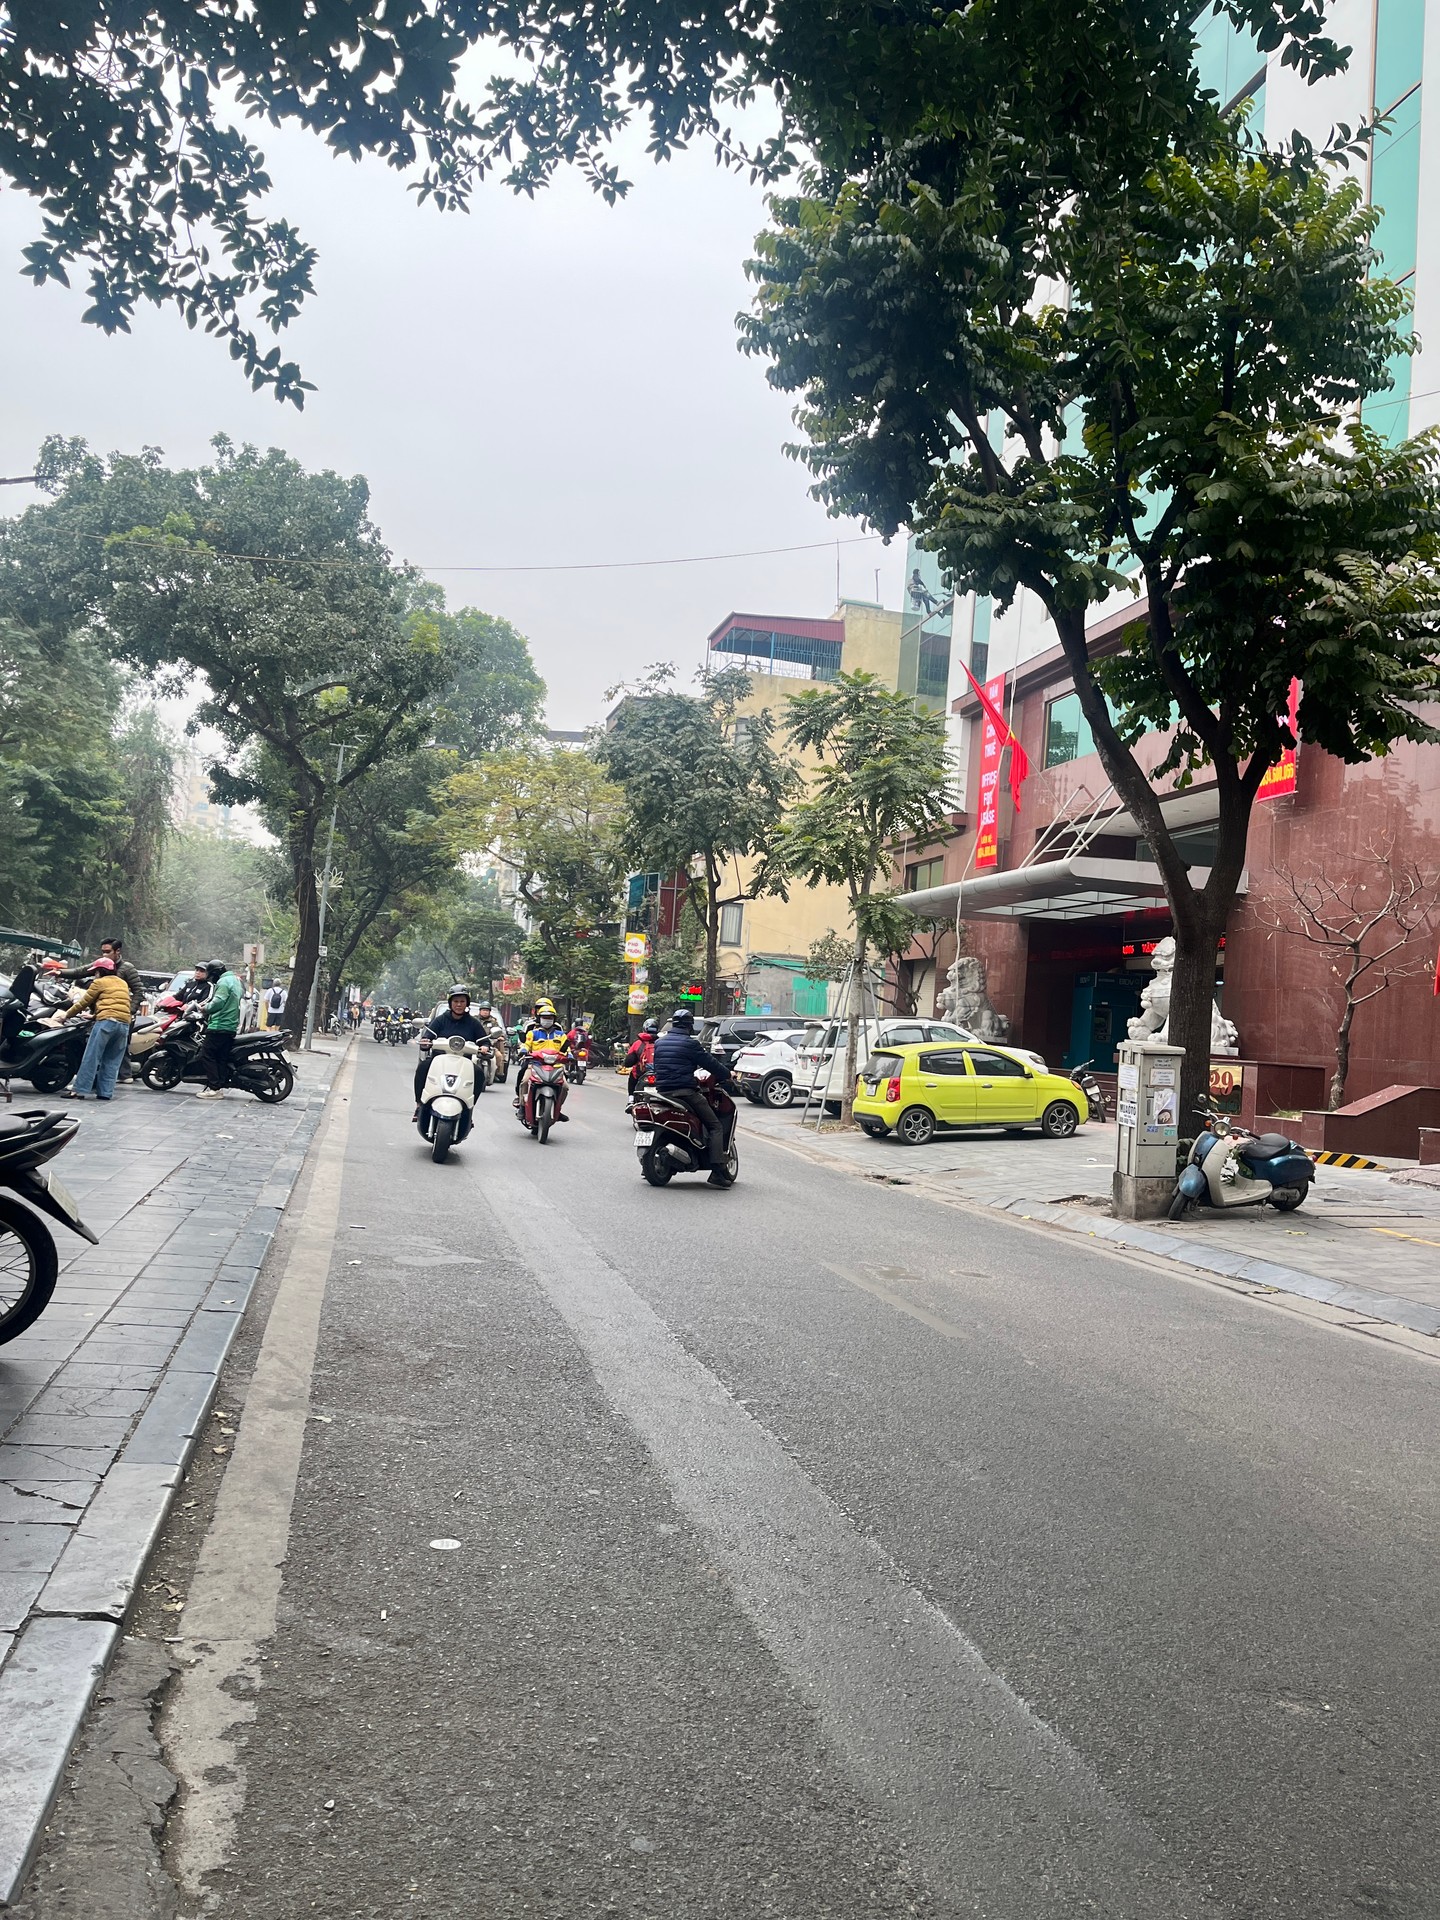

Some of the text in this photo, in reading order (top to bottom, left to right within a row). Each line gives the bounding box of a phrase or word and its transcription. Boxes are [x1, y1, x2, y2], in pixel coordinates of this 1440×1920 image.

[981, 769, 997, 789] OFFICE
[980, 809, 995, 826] LEASE
[1209, 1071, 1234, 1096] 29
